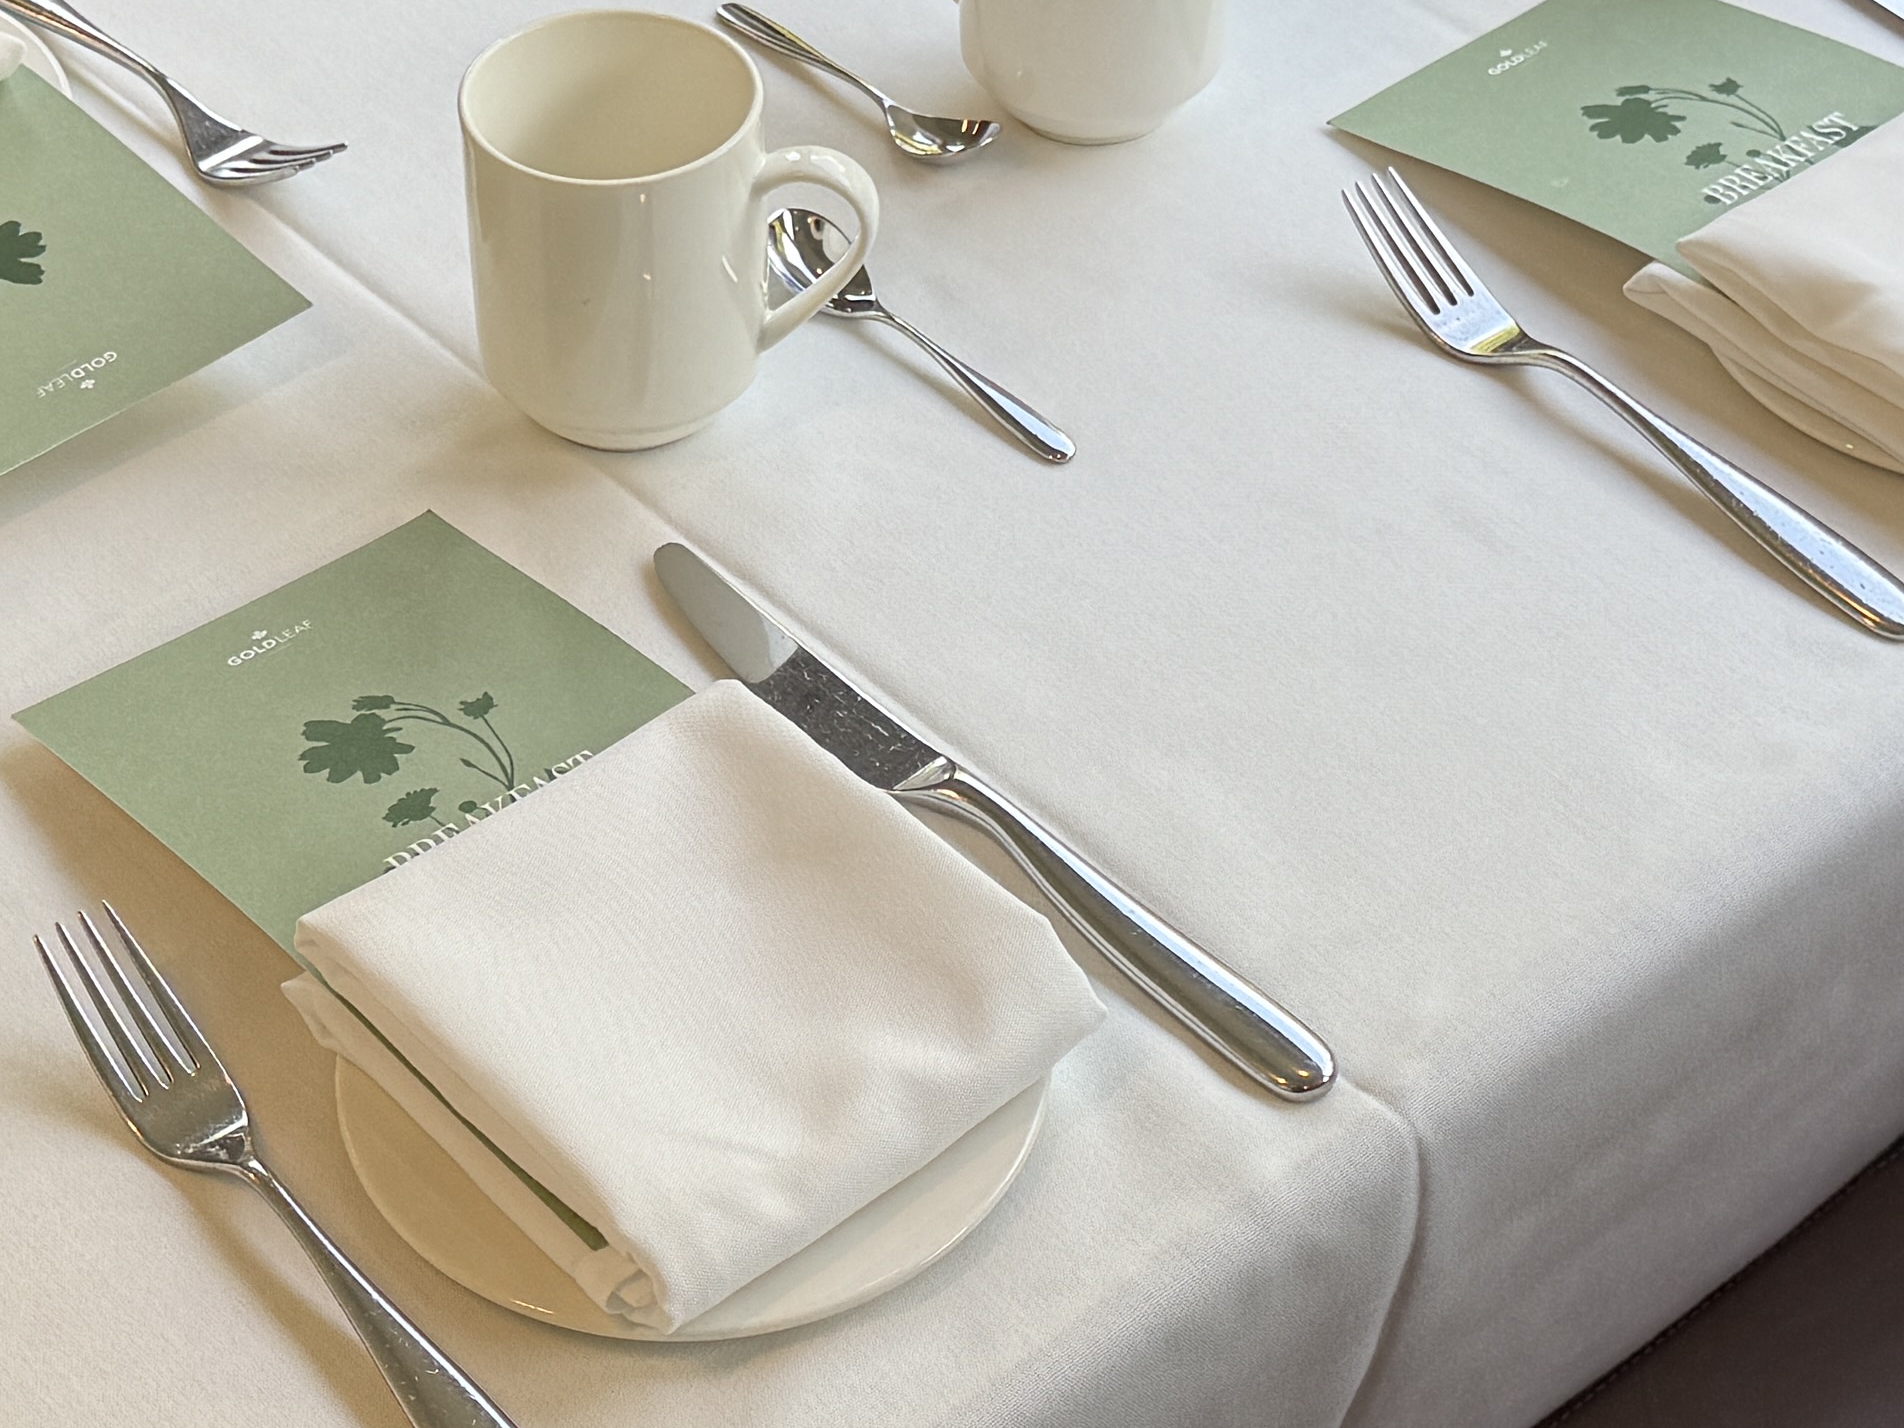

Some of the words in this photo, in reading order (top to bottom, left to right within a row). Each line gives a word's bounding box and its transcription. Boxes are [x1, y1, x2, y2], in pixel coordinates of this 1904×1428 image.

[1700, 110, 1859, 205] BREAKFAST
[36, 351, 118, 399] GOLDLEAF
[227, 619, 313, 666] GOLDLEAF
